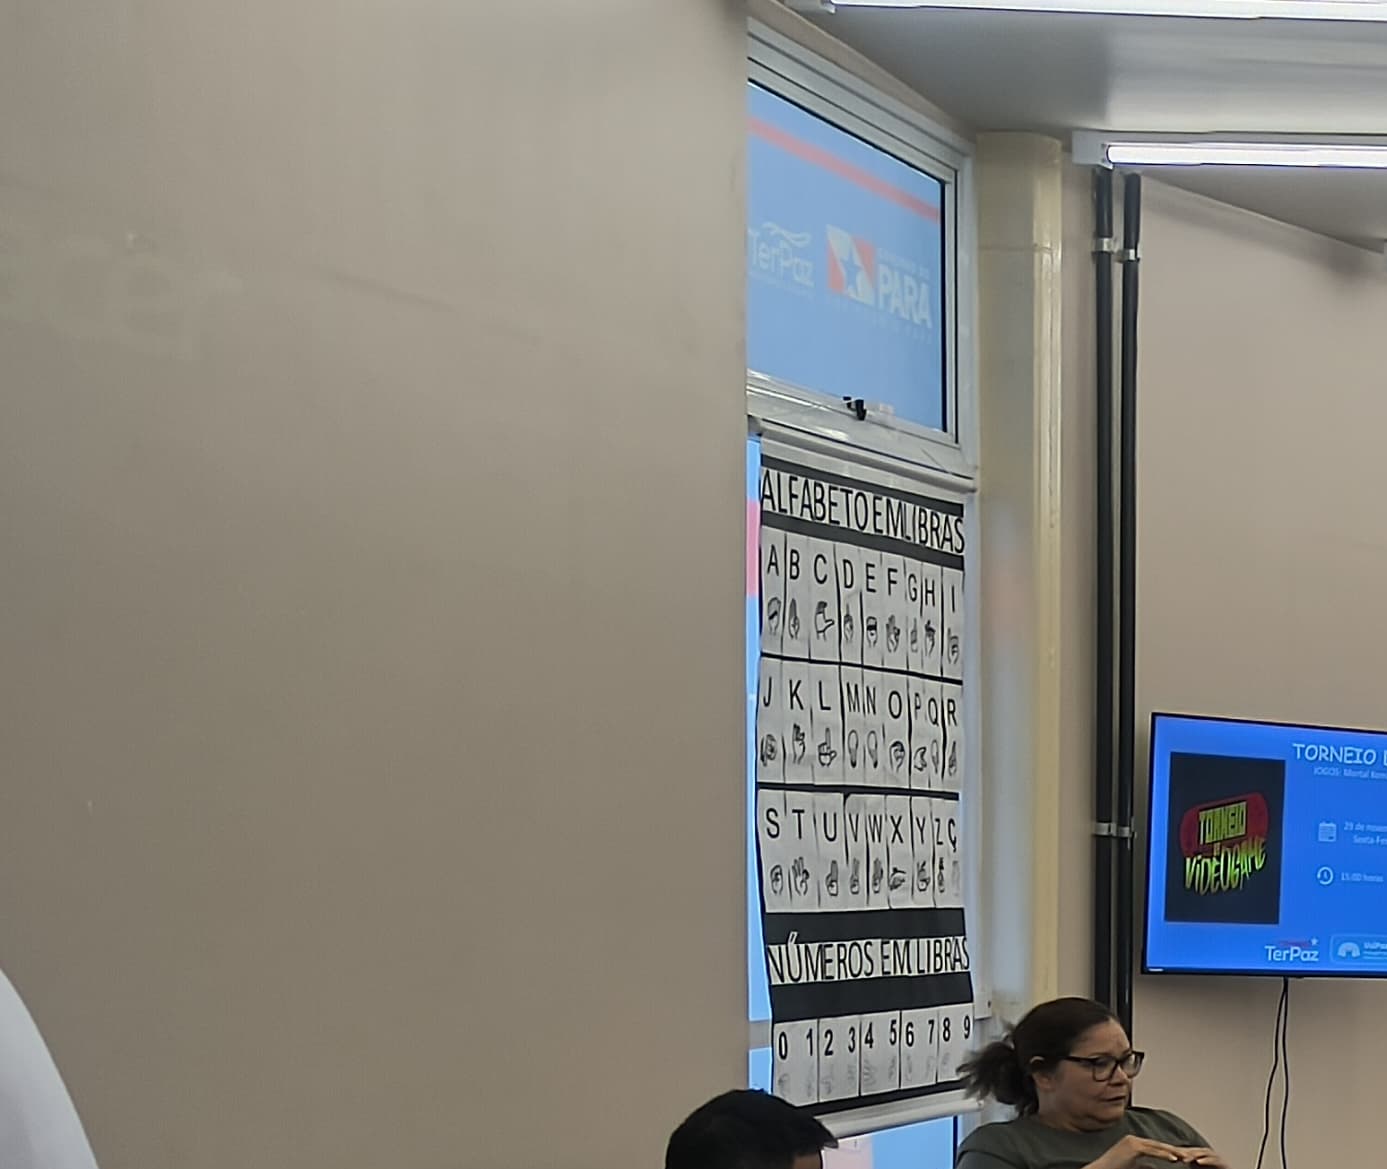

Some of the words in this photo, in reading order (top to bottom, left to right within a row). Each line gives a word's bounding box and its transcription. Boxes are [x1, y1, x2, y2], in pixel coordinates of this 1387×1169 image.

[761, 470, 868, 531] ALFABETO
[873, 496, 904, 537] EM
[904, 503, 965, 554] LIBRAS
[767, 545, 779, 576] A
[789, 549, 800, 580] B
[814, 554, 828, 584] C
[843, 559, 854, 589] D
[866, 563, 876, 593] E
[888, 568, 898, 596] F
[908, 574, 918, 602] G
[925, 578, 935, 607] H
[951, 585, 955, 613] I
[763, 677, 772, 707] J
[789, 679, 804, 710] K
[819, 681, 831, 711] L
[847, 683, 860, 713] M
[866, 686, 876, 715] N
[888, 691, 902, 719] O
[915, 693, 921, 720] P
[928, 698, 939, 727] Q
[947, 699, 957, 726] R
[1292, 743, 1377, 766] TORNEIO
[766, 808, 780, 839] S
[792, 809, 805, 840] T
[824, 812, 837, 842] U
[850, 813, 859, 842] V
[869, 814, 883, 843] W
[890, 815, 904, 844] X
[916, 817, 926, 844] Y
[936, 818, 943, 845] Z
[948, 818, 957, 853] Ç
[1199, 801, 1247, 845] TORNEIO
[768, 931, 874, 984] NÚMEROS
[880, 939, 911, 976] EM
[916, 936, 970, 974] LIBRAS
[1264, 945, 1319, 962] TerPaz
[778, 1031, 788, 1060] 0
[806, 1028, 813, 1056] 1
[824, 1029, 833, 1056] 2
[848, 1027, 856, 1053] 3
[864, 1022, 874, 1048] 4
[889, 1019, 897, 1045] 5
[905, 1022, 914, 1047] 6
[928, 1019, 935, 1044] 7
[942, 1017, 951, 1042] 8
[963, 1015, 971, 1039] 9
